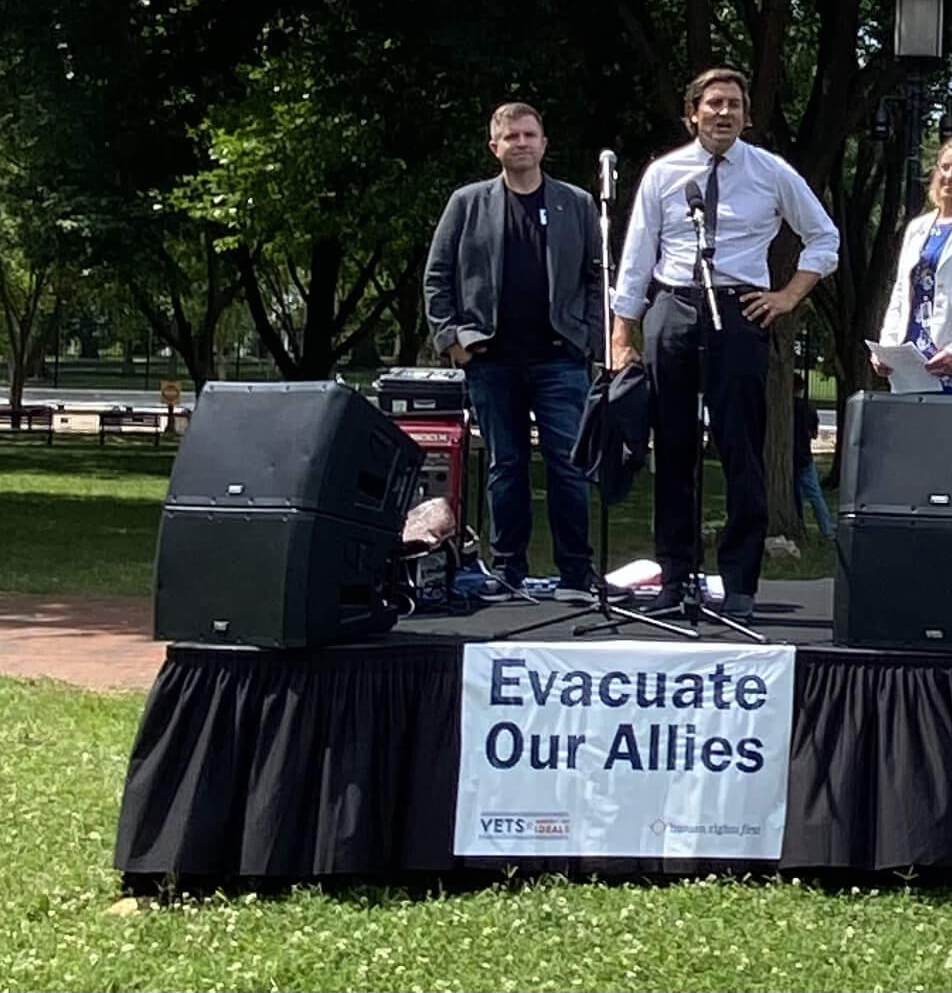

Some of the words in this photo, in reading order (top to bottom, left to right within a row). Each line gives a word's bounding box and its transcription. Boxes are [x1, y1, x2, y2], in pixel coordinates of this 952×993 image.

[489, 658, 767, 710] Evacuate
[485, 721, 585, 769] Our
[603, 723, 764, 773] Allies
[480, 818, 525, 833] VETS
